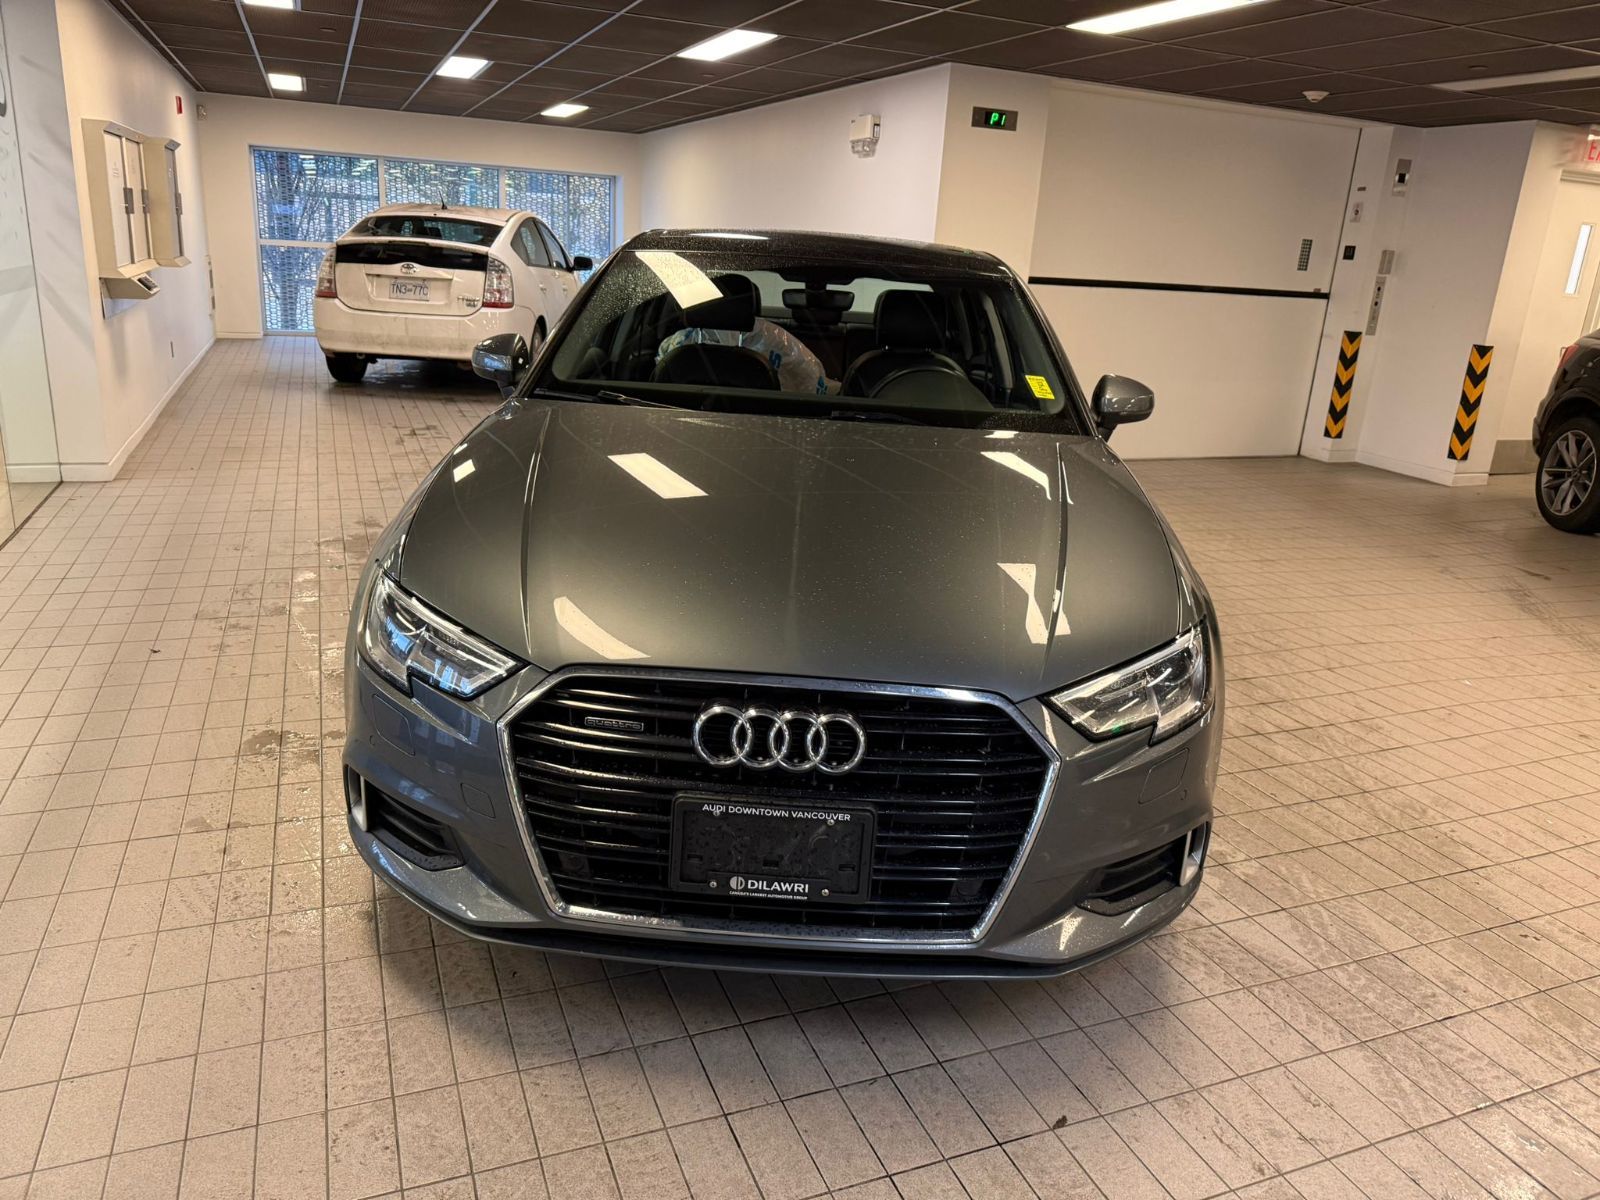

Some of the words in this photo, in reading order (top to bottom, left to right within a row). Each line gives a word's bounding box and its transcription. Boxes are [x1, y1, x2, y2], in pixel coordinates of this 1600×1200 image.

[990, 112, 1006, 126] P1
[587, 719, 642, 730] quattro
[702, 803, 726, 813] AUDI
[728, 805, 789, 818] DOWNTOWN
[791, 810, 851, 822] VANCOUVER
[747, 879, 809, 893] DILAWRI
